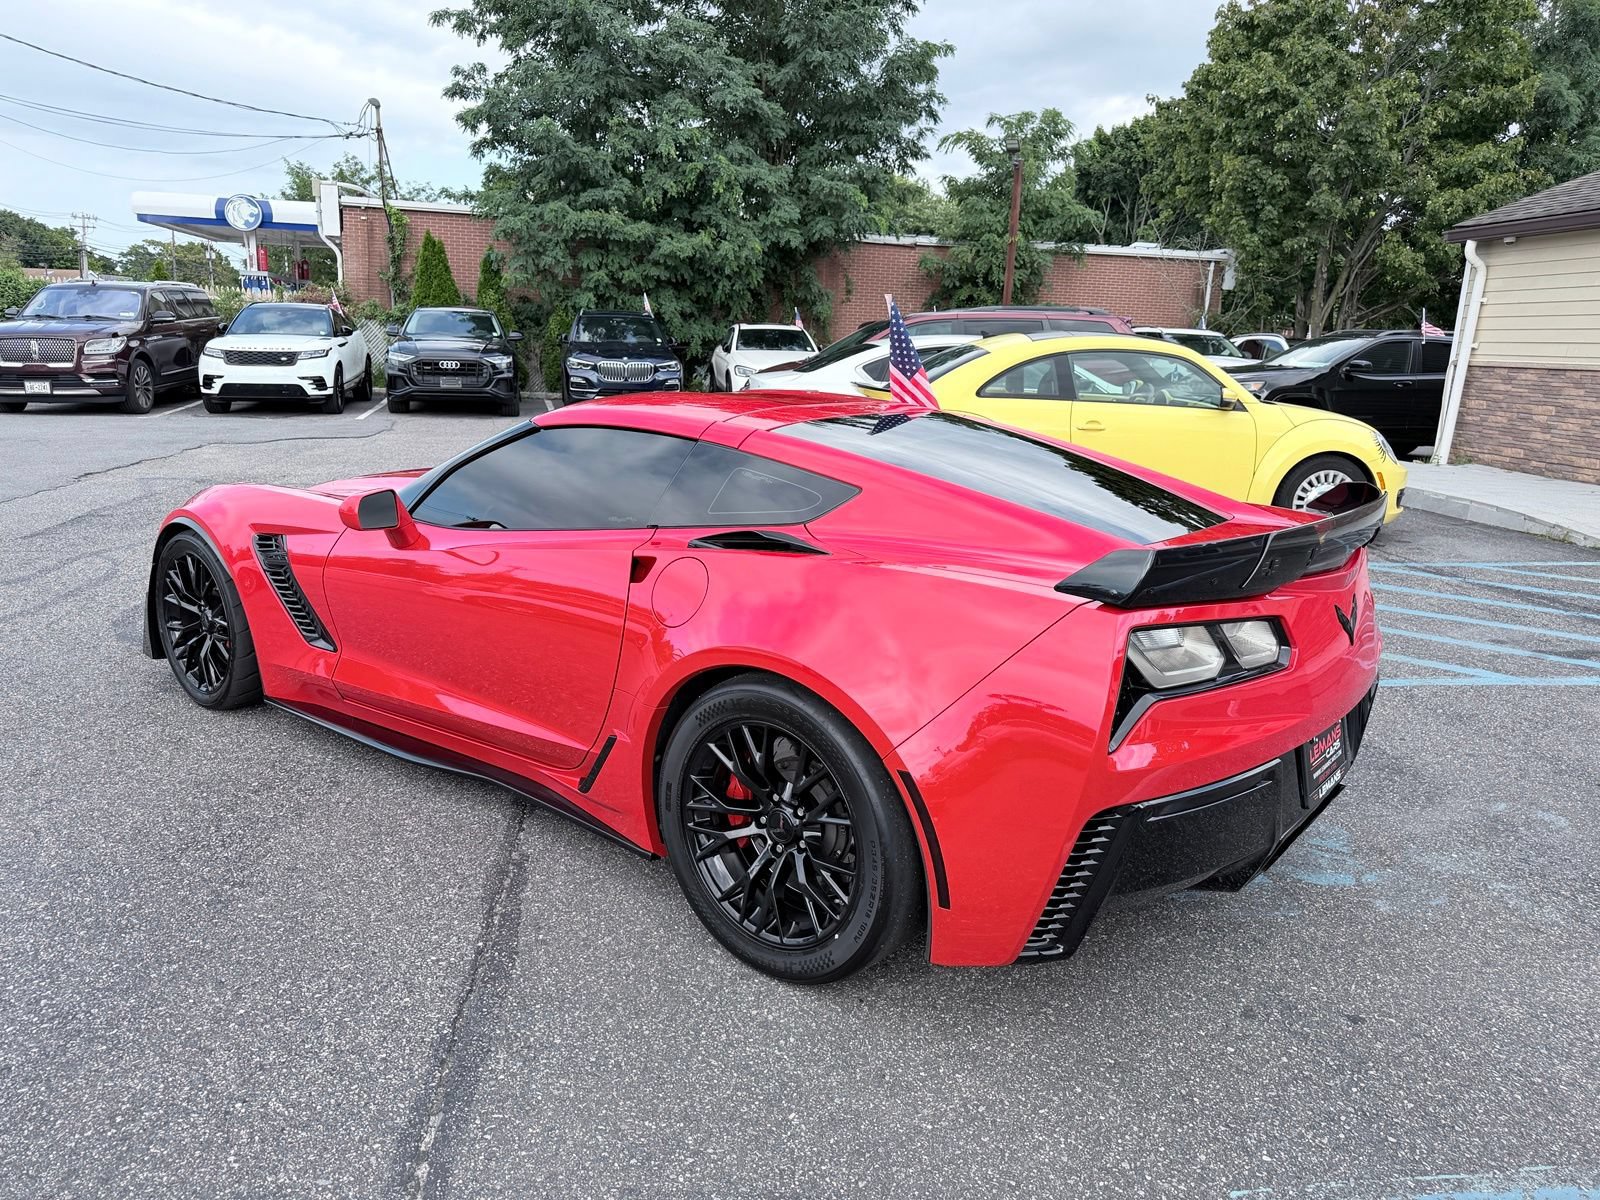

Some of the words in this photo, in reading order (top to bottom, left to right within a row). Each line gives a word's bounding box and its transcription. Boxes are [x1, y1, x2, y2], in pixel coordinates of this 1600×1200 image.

[1310, 723, 1341, 764] LEMANS
[1325, 739, 1341, 759] CARS
[1318, 769, 1342, 799] LEMANS
